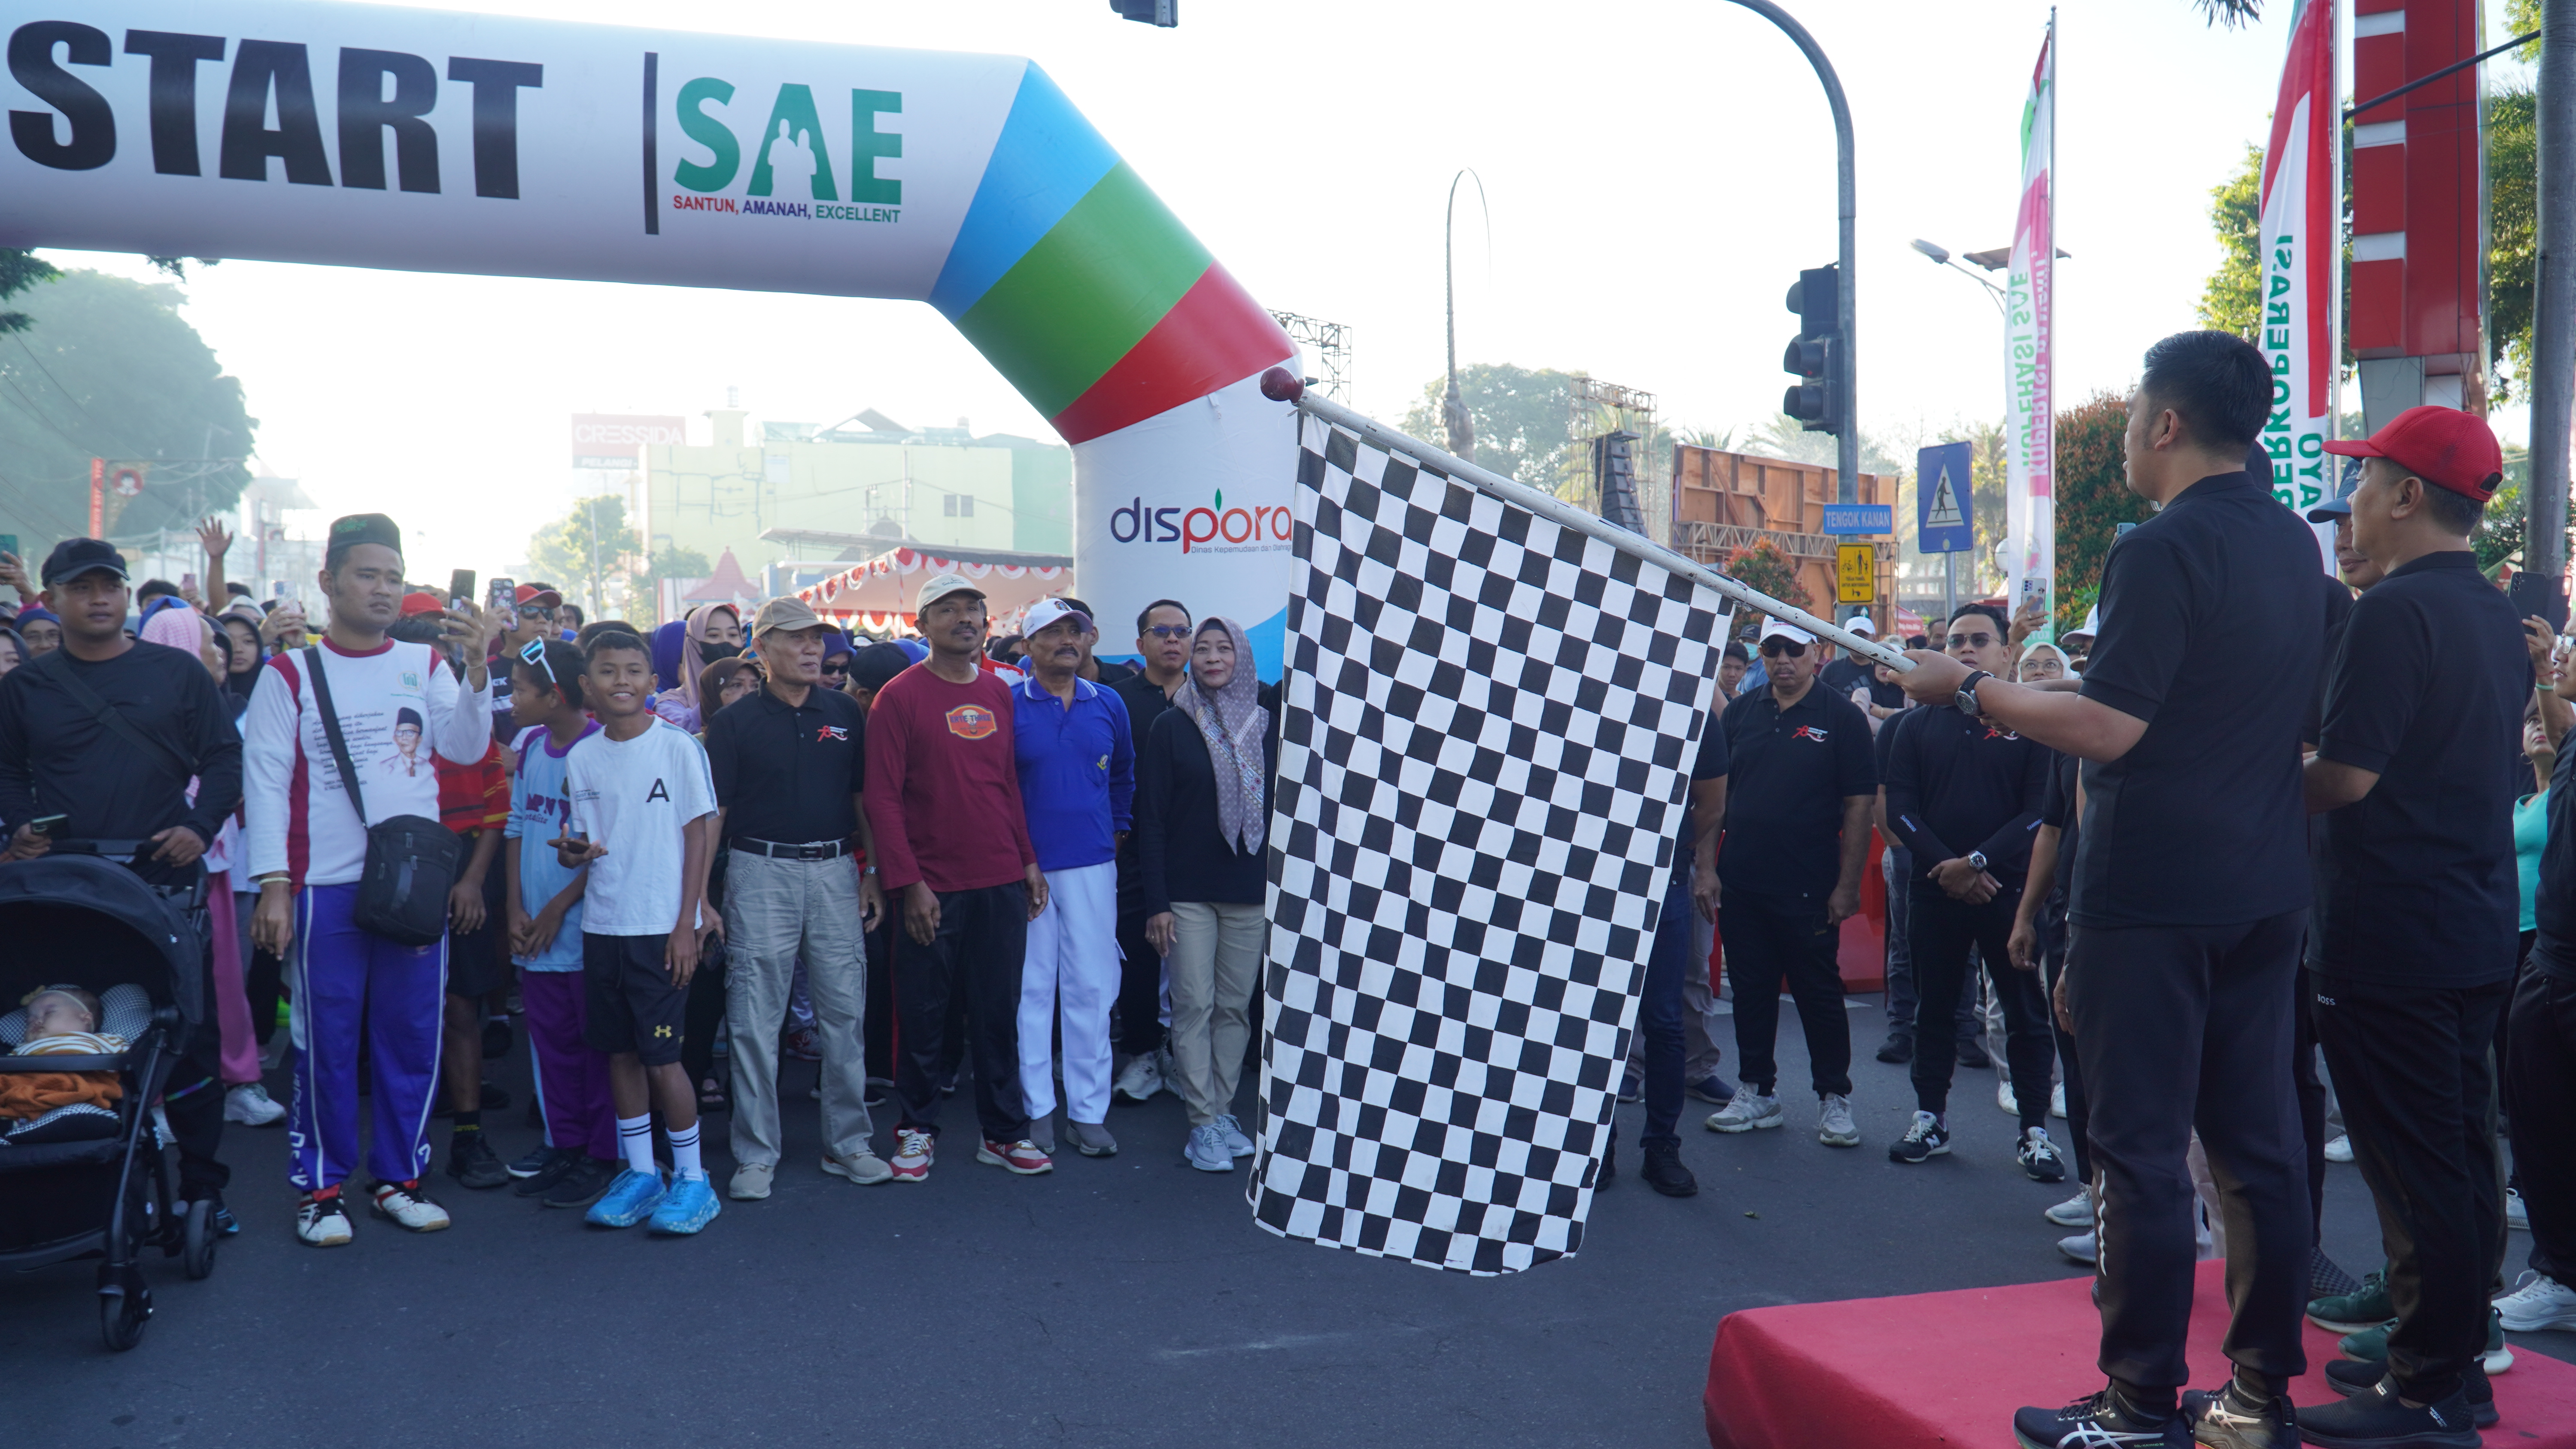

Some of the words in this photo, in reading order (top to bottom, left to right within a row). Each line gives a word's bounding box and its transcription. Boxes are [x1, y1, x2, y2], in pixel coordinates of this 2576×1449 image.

[7, 20, 544, 200] START
[674, 77, 902, 205] SAE
[673, 195, 739, 215] SANTUN,
[743, 200, 811, 220] AMANAH,
[816, 205, 901, 223] EXCELLENT
[575, 424, 684, 445] CRESSIDA
[581, 457, 632, 467] PELANGI
[1111, 497, 1292, 554] dispora
[1826, 511, 1859, 527] TENGOK
[1861, 511, 1890, 527] KANAN
[1214, 545, 1260, 554] Kepemudaan
[1273, 544, 1292, 552] Olahrag
[646, 778, 670, 803] A
[2318, 993, 2336, 1005] BOSS
